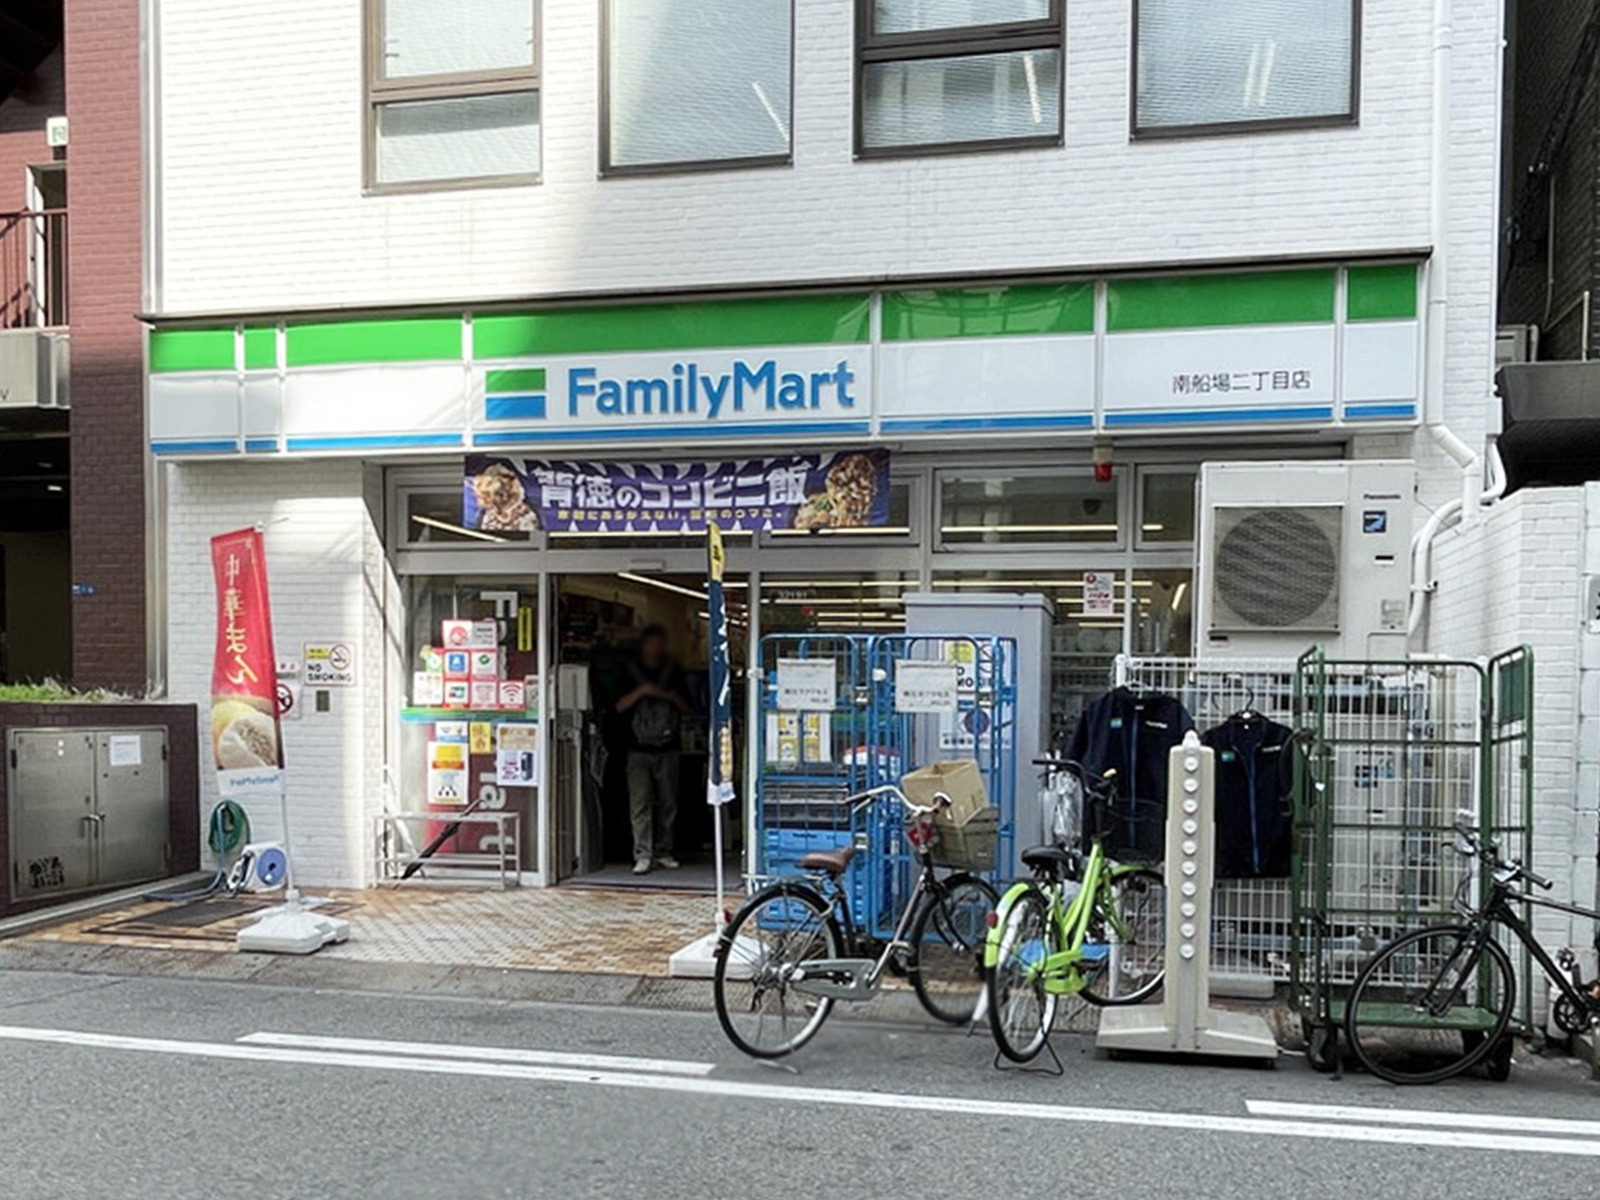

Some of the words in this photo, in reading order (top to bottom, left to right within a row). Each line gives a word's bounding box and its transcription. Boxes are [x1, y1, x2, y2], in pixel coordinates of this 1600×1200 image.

[568, 360, 856, 419] FamilyMart
[1172, 371, 1310, 394] 南船場二丁目店
[533, 462, 812, 509] 背徳のコンビニ飯
[224, 553, 258, 684] 中華まん
[308, 663, 322, 673] NO
[308, 673, 352, 682] SMOKING
